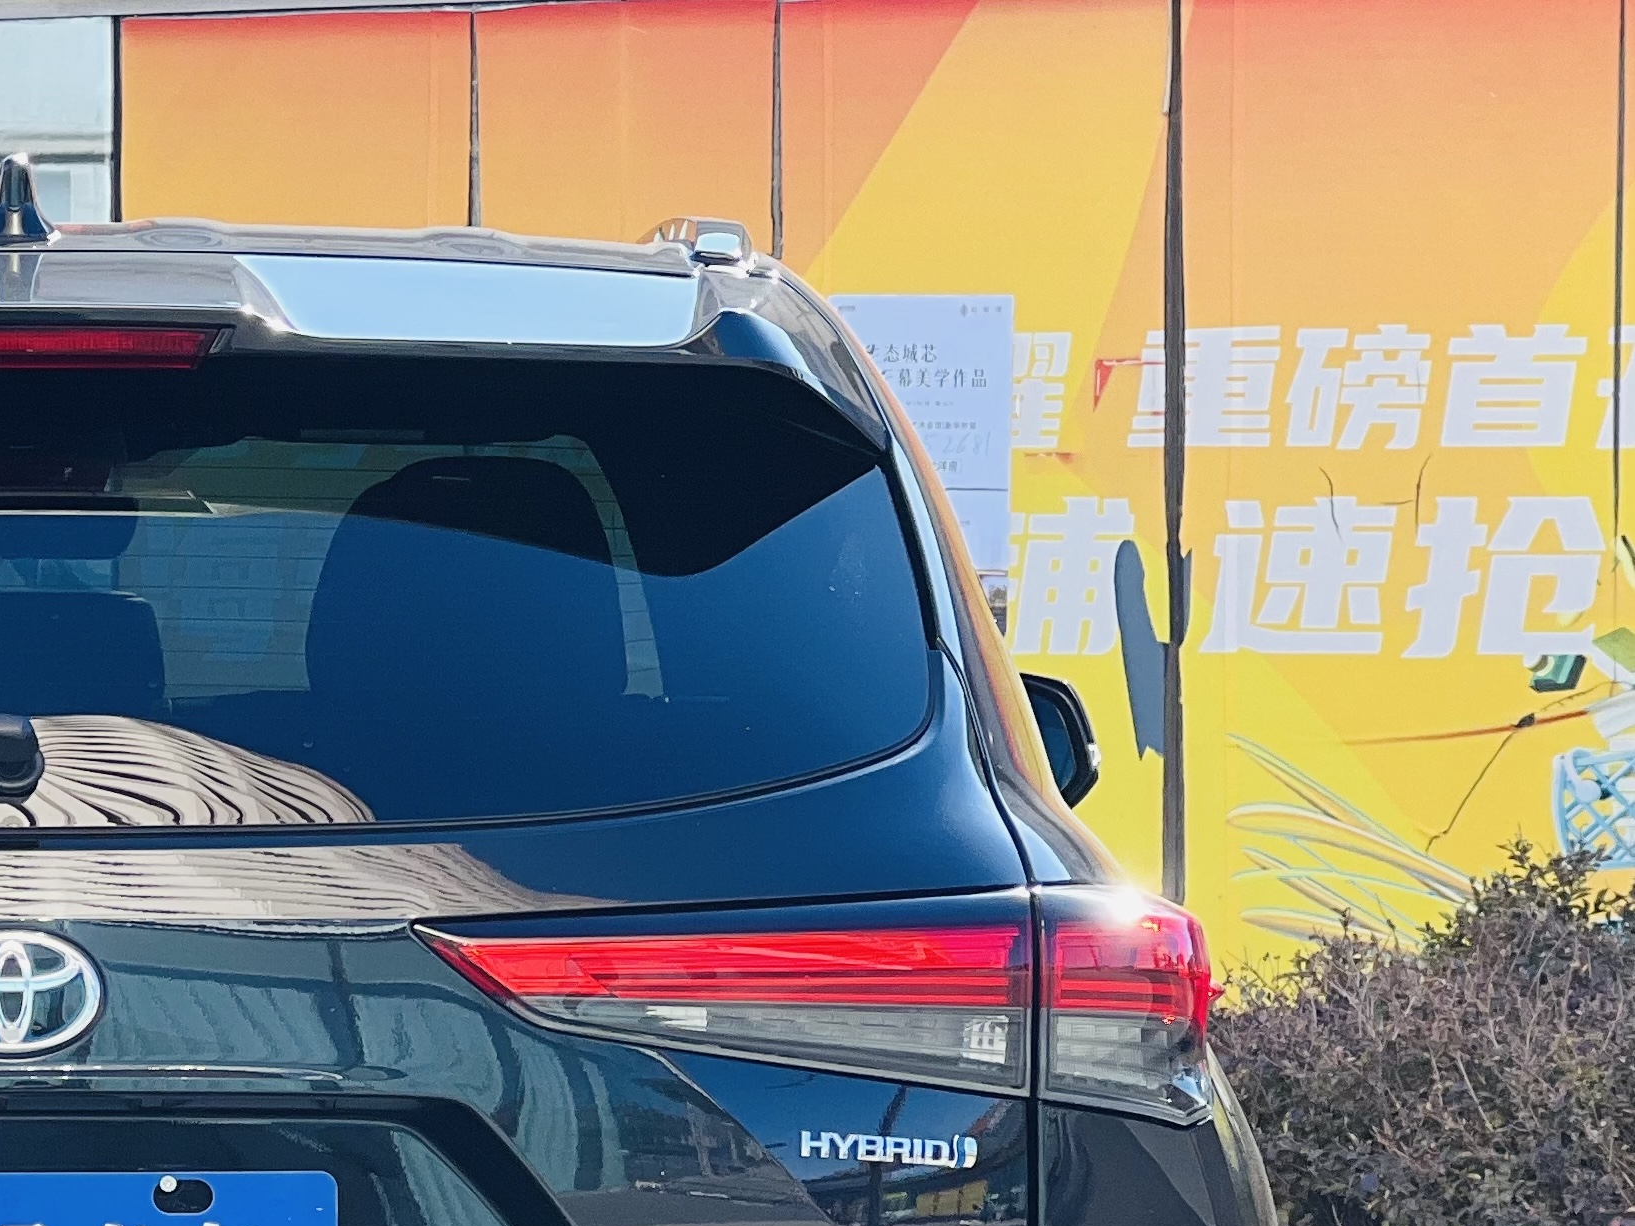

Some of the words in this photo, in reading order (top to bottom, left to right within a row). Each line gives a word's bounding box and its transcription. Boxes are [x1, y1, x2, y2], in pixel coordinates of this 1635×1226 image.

[1126, 324, 1635, 450] 重磅首
[800, 1130, 952, 1167] HYBRID
